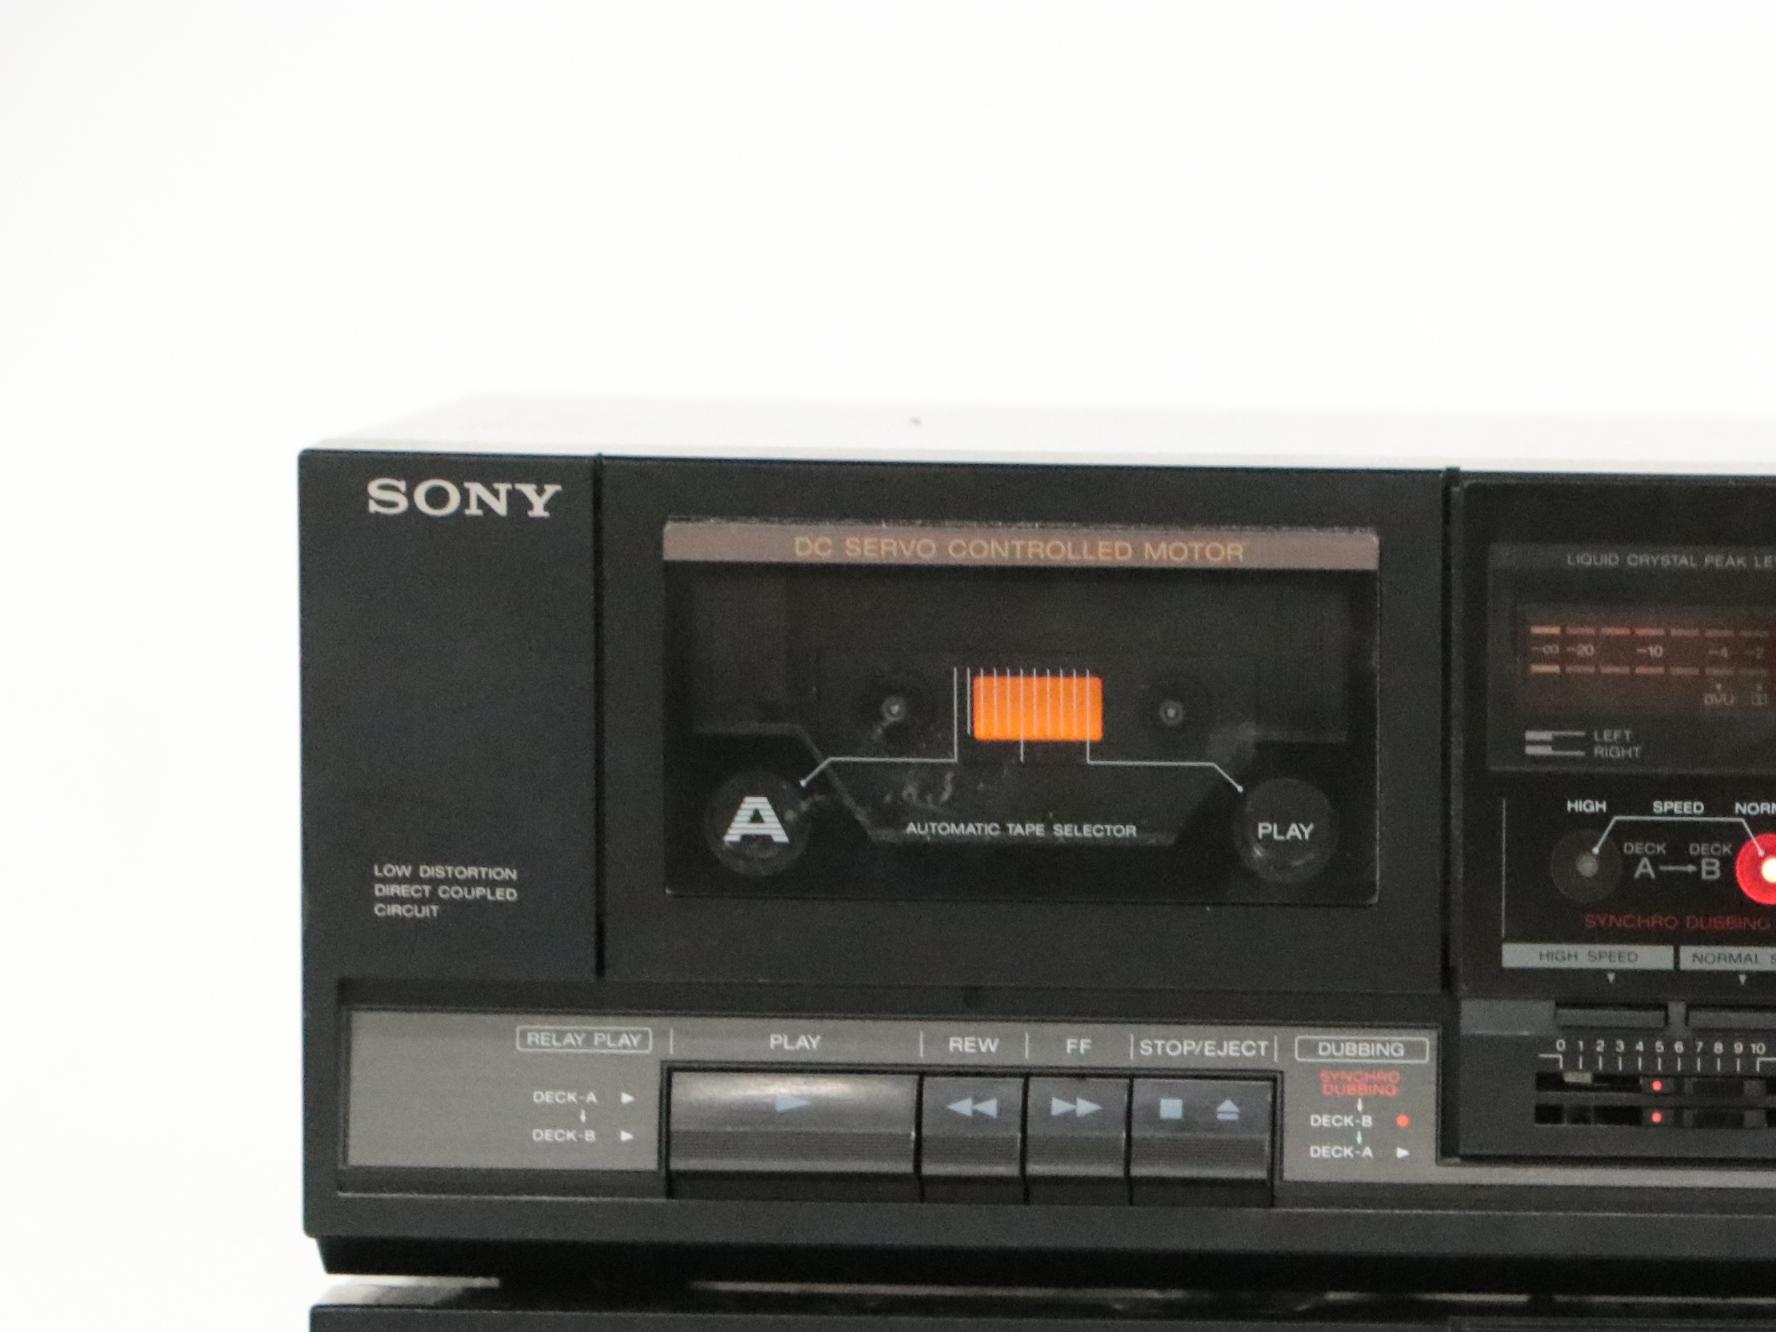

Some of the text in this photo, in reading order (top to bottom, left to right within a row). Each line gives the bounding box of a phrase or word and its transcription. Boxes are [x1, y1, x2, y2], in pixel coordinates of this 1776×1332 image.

[367, 478, 562, 517] SONY
[794, 537, 1245, 563] DC SERVO CONTROLLED MOTOR
[1567, 552, 1620, 568] LIQUID
[1627, 553, 1698, 568] CRYSTAL
[1705, 554, 1748, 568] PEAK
[1594, 729, 1633, 743] LEFT
[1594, 746, 1642, 759] RIGHT
[1567, 800, 1607, 814] HIGH
[1653, 800, 1705, 815] SPEED
[724, 795, 789, 843] A
[906, 822, 1137, 838] AUTOMATIC TAPE SELECTOR
[1257, 823, 1314, 841] PLAY
[1623, 842, 1666, 856] DECK
[1689, 843, 1733, 857] DECK
[375, 864, 518, 881] LOW DISTORTION
[375, 883, 518, 901] DIRECT COUPLED
[375, 903, 439, 918] CIRCUIT
[1584, 913, 1771, 931] SYNCHRO DUBBING
[1538, 950, 1639, 964] HIGH SPEED
[1692, 951, 1763, 965] NORMAL
[527, 1032, 642, 1048] RELAY PLAY
[770, 1034, 821, 1050] PLAY
[949, 1037, 999, 1053] REW
[1066, 1039, 1092, 1053] FF
[1140, 1039, 1268, 1057] STOP/EJECT
[1318, 1042, 1405, 1057] DUBBING
[1320, 1071, 1401, 1083] SYNCHRO
[533, 1091, 598, 1103] DECK-A
[1322, 1084, 1398, 1095] DUBBING
[1310, 1115, 1373, 1128] DECK-B
[532, 1129, 595, 1142] DECK-B
[1310, 1146, 1373, 1158] DECK-A
